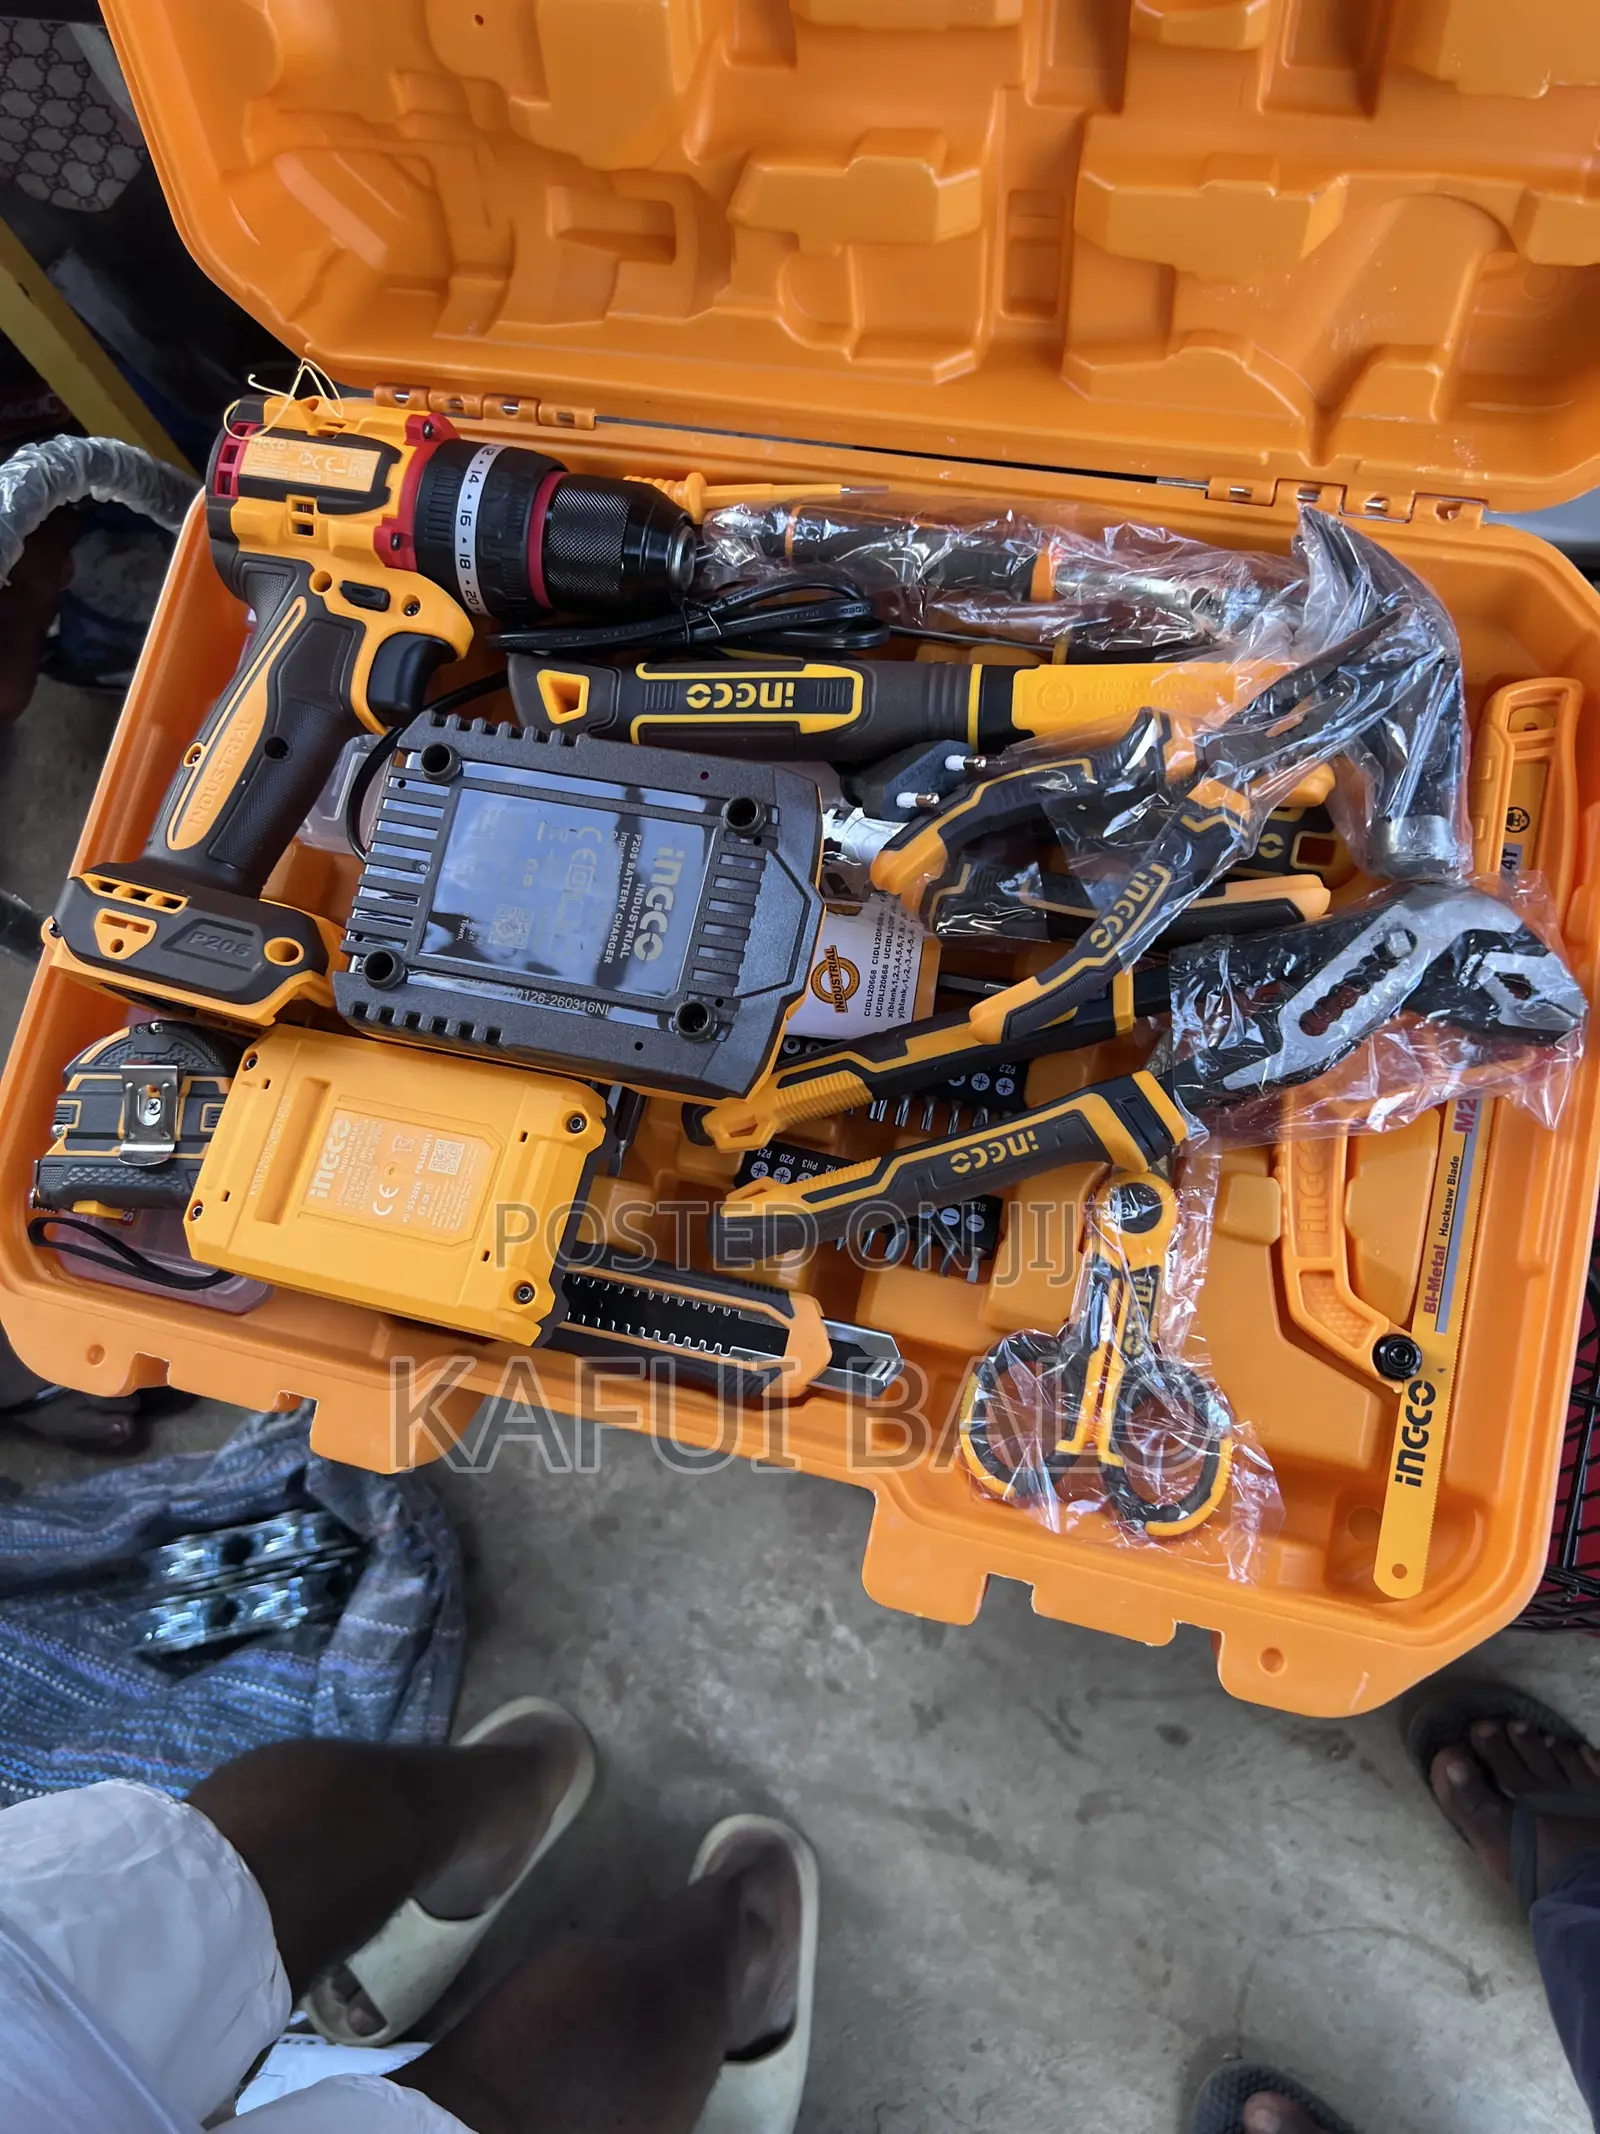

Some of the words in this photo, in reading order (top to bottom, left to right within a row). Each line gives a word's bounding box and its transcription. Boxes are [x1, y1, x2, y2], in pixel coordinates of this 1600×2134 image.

[468, 470, 482, 484] 14
[460, 509, 473, 527] 16
[459, 553, 472, 570] 18
[465, 591, 480, 606] 20
[188, 717, 255, 828] INDUSTRIAL
[617, 860, 639, 914] BATTERY
[619, 883, 647, 960] INDUSTRIAL
[186, 931, 255, 958] P20S
[603, 913, 625, 965] CHARGER
[825, 945, 847, 1013] INDUSTRIAL
[864, 970, 877, 1017] CIDLI20668
[875, 964, 889, 1018] UCIDLI20668
[999, 1064, 1017, 1075] PZ2
[779, 1153, 796, 1165] PZ0
[801, 1159, 819, 1171] PH3
[1446, 1155, 1460, 1186] Blade
[1438, 1188, 1455, 1237] Hacksaw
